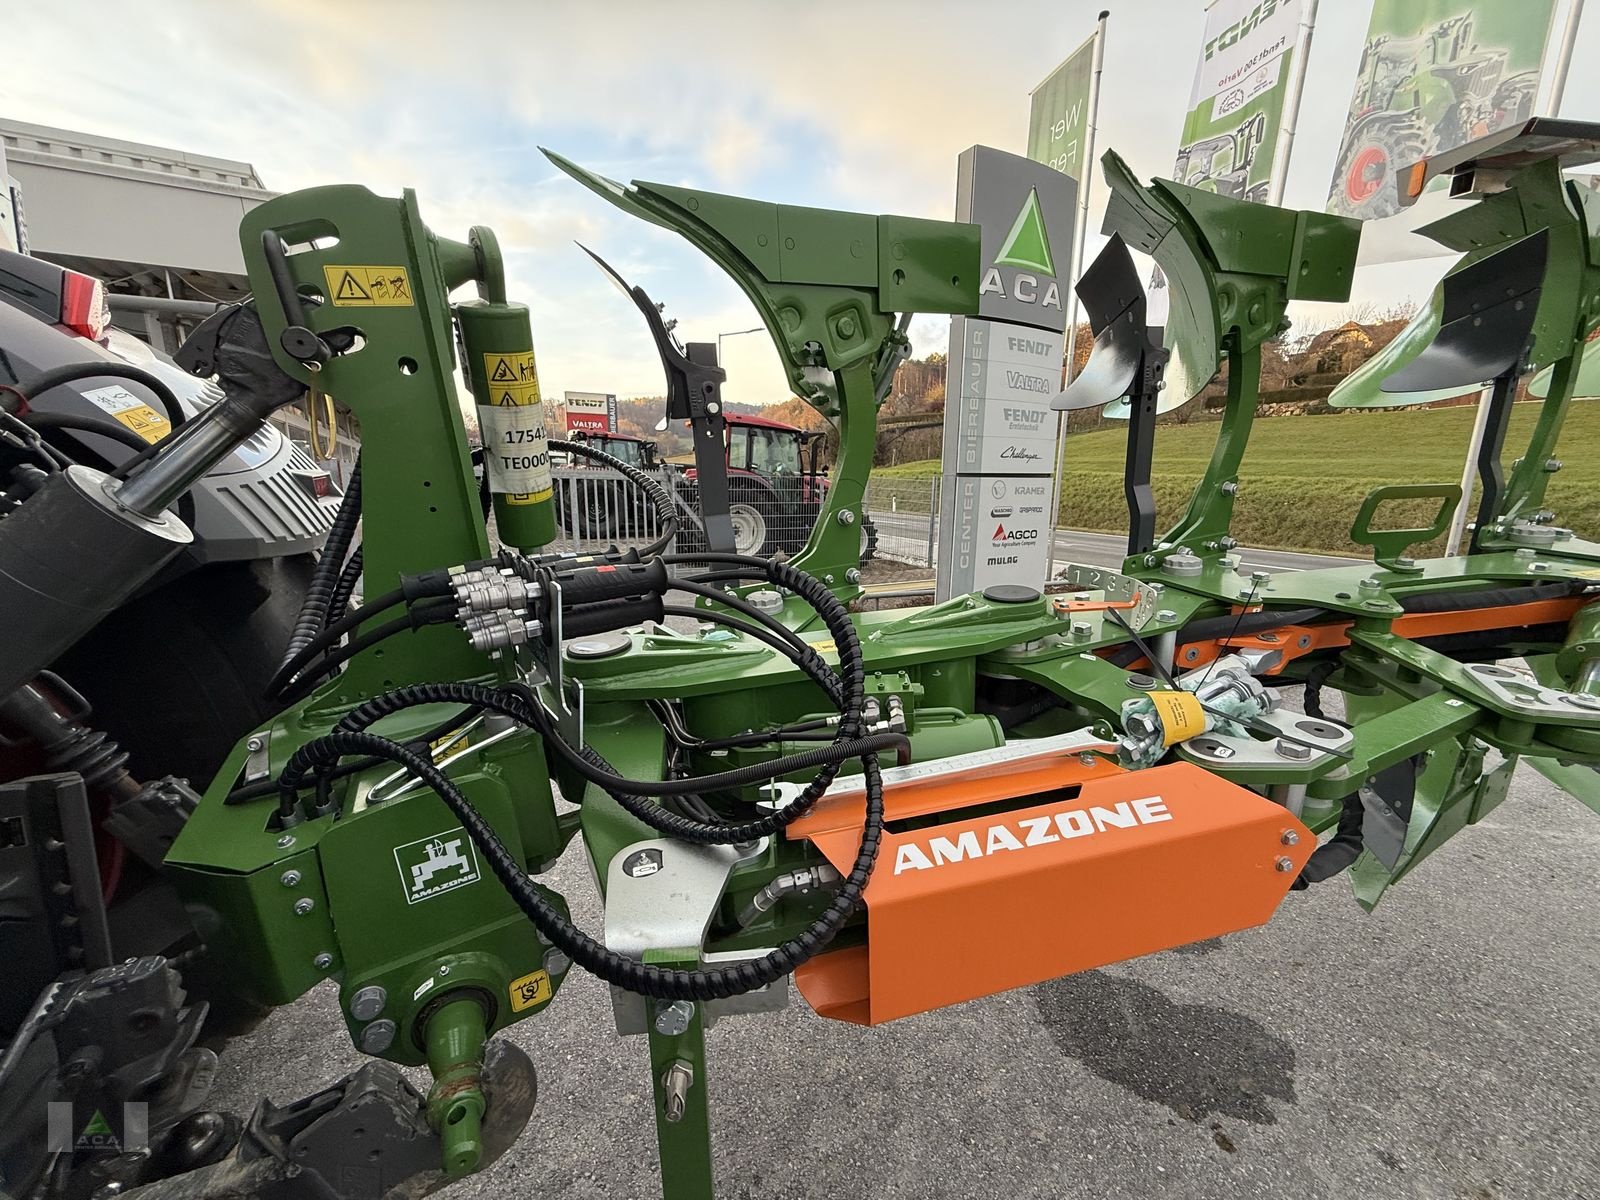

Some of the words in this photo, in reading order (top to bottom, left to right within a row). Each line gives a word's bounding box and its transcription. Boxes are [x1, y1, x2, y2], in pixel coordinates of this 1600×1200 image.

[979, 267, 1063, 312] ACA
[1008, 337, 1052, 356] FENDT
[1006, 370, 1050, 394] VALTRA
[568, 398, 604, 408] FENDT
[966, 330, 984, 464] BIERBAUER
[572, 420, 603, 428] VALTRA
[1003, 408, 1048, 424] FENDT
[1000, 446, 1044, 464] Challenger
[1014, 486, 1045, 496] KRAMER
[960, 483, 974, 568] CENTER
[1006, 529, 1038, 540] AGCO
[987, 556, 1018, 566] MULAG
[893, 795, 1174, 876] AMAZONE
[410, 872, 477, 901] AMAZONE
